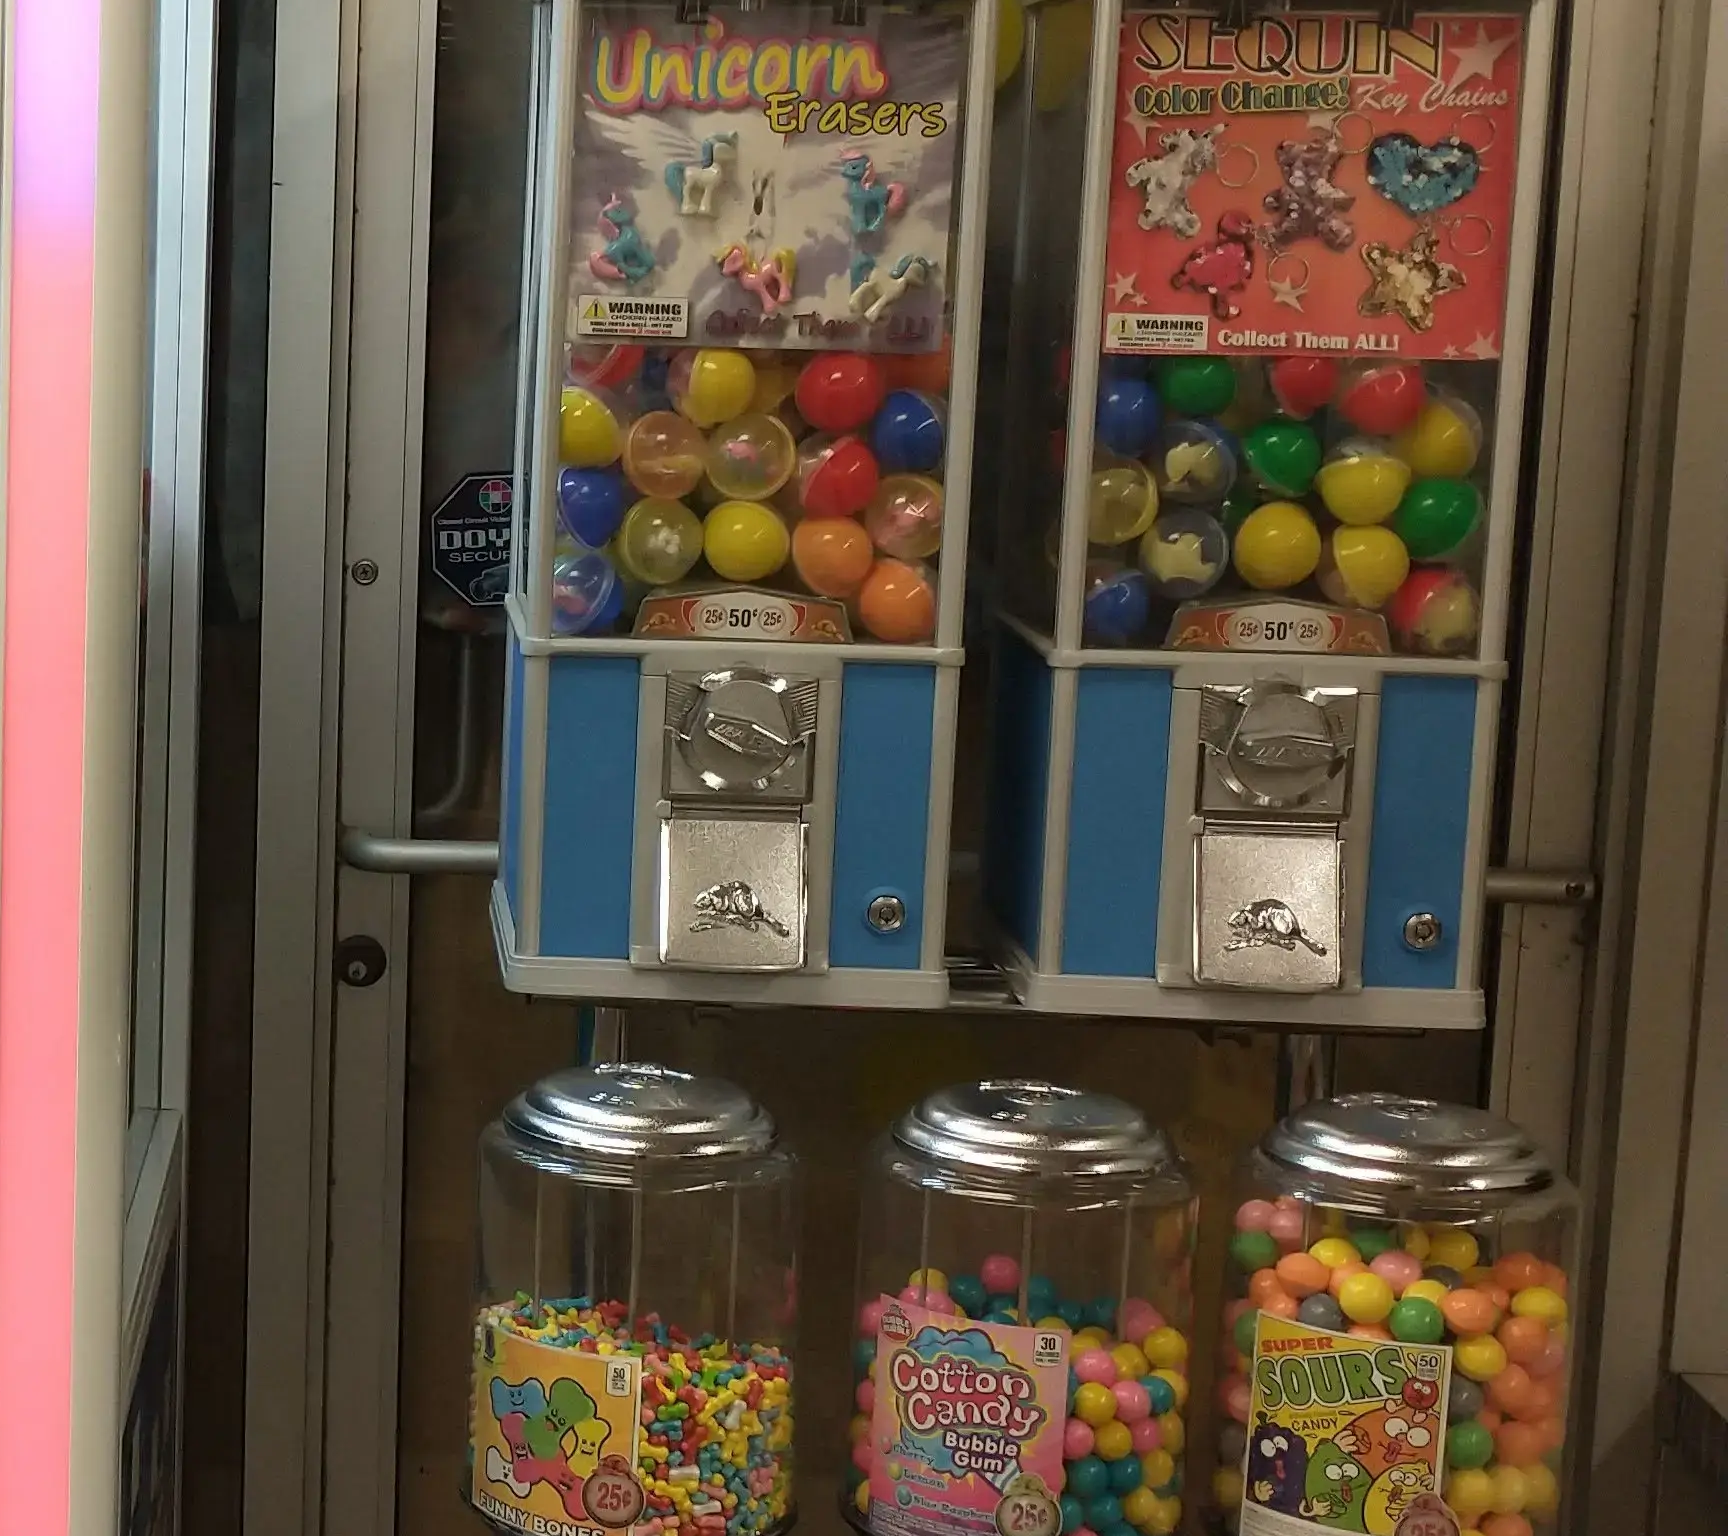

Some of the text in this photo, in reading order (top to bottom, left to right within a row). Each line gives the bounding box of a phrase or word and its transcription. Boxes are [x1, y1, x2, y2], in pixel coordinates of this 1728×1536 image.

[1135, 14, 1441, 79] SEQUIN
[592, 16, 888, 107] Unicorn
[1134, 76, 1508, 117] Color Change! Key Chains
[764, 90, 947, 138] Erasers
[608, 302, 682, 315] WARNING
[1136, 319, 1204, 331] WARNING
[1217, 329, 1287, 348] Collect
[1294, 330, 1351, 349] Them
[1355, 333, 1399, 351] ALL!
[440, 528, 511, 550] DOY
[448, 550, 511, 563] SECUR
[705, 608, 782, 628] 25¢ 50¢ 25¢
[1239, 621, 1319, 641] 25¢ 50¢ 25¢
[1041, 1336, 1056, 1351] 30
[1261, 1336, 1334, 1353] SUPER
[613, 1367, 625, 1379] 50
[1420, 1356, 1439, 1369] 50
[893, 1353, 1030, 1399] Cotton
[1256, 1346, 1407, 1407] SOURS
[907, 1392, 1041, 1437] Candy
[1292, 1417, 1338, 1432] CANDY
[945, 1430, 1019, 1456] Bubble
[954, 1450, 1003, 1472] Gum
[597, 1481, 632, 1511] 25¢
[478, 1489, 530, 1528] FUNNY
[1010, 1501, 1048, 1532] 25¢
